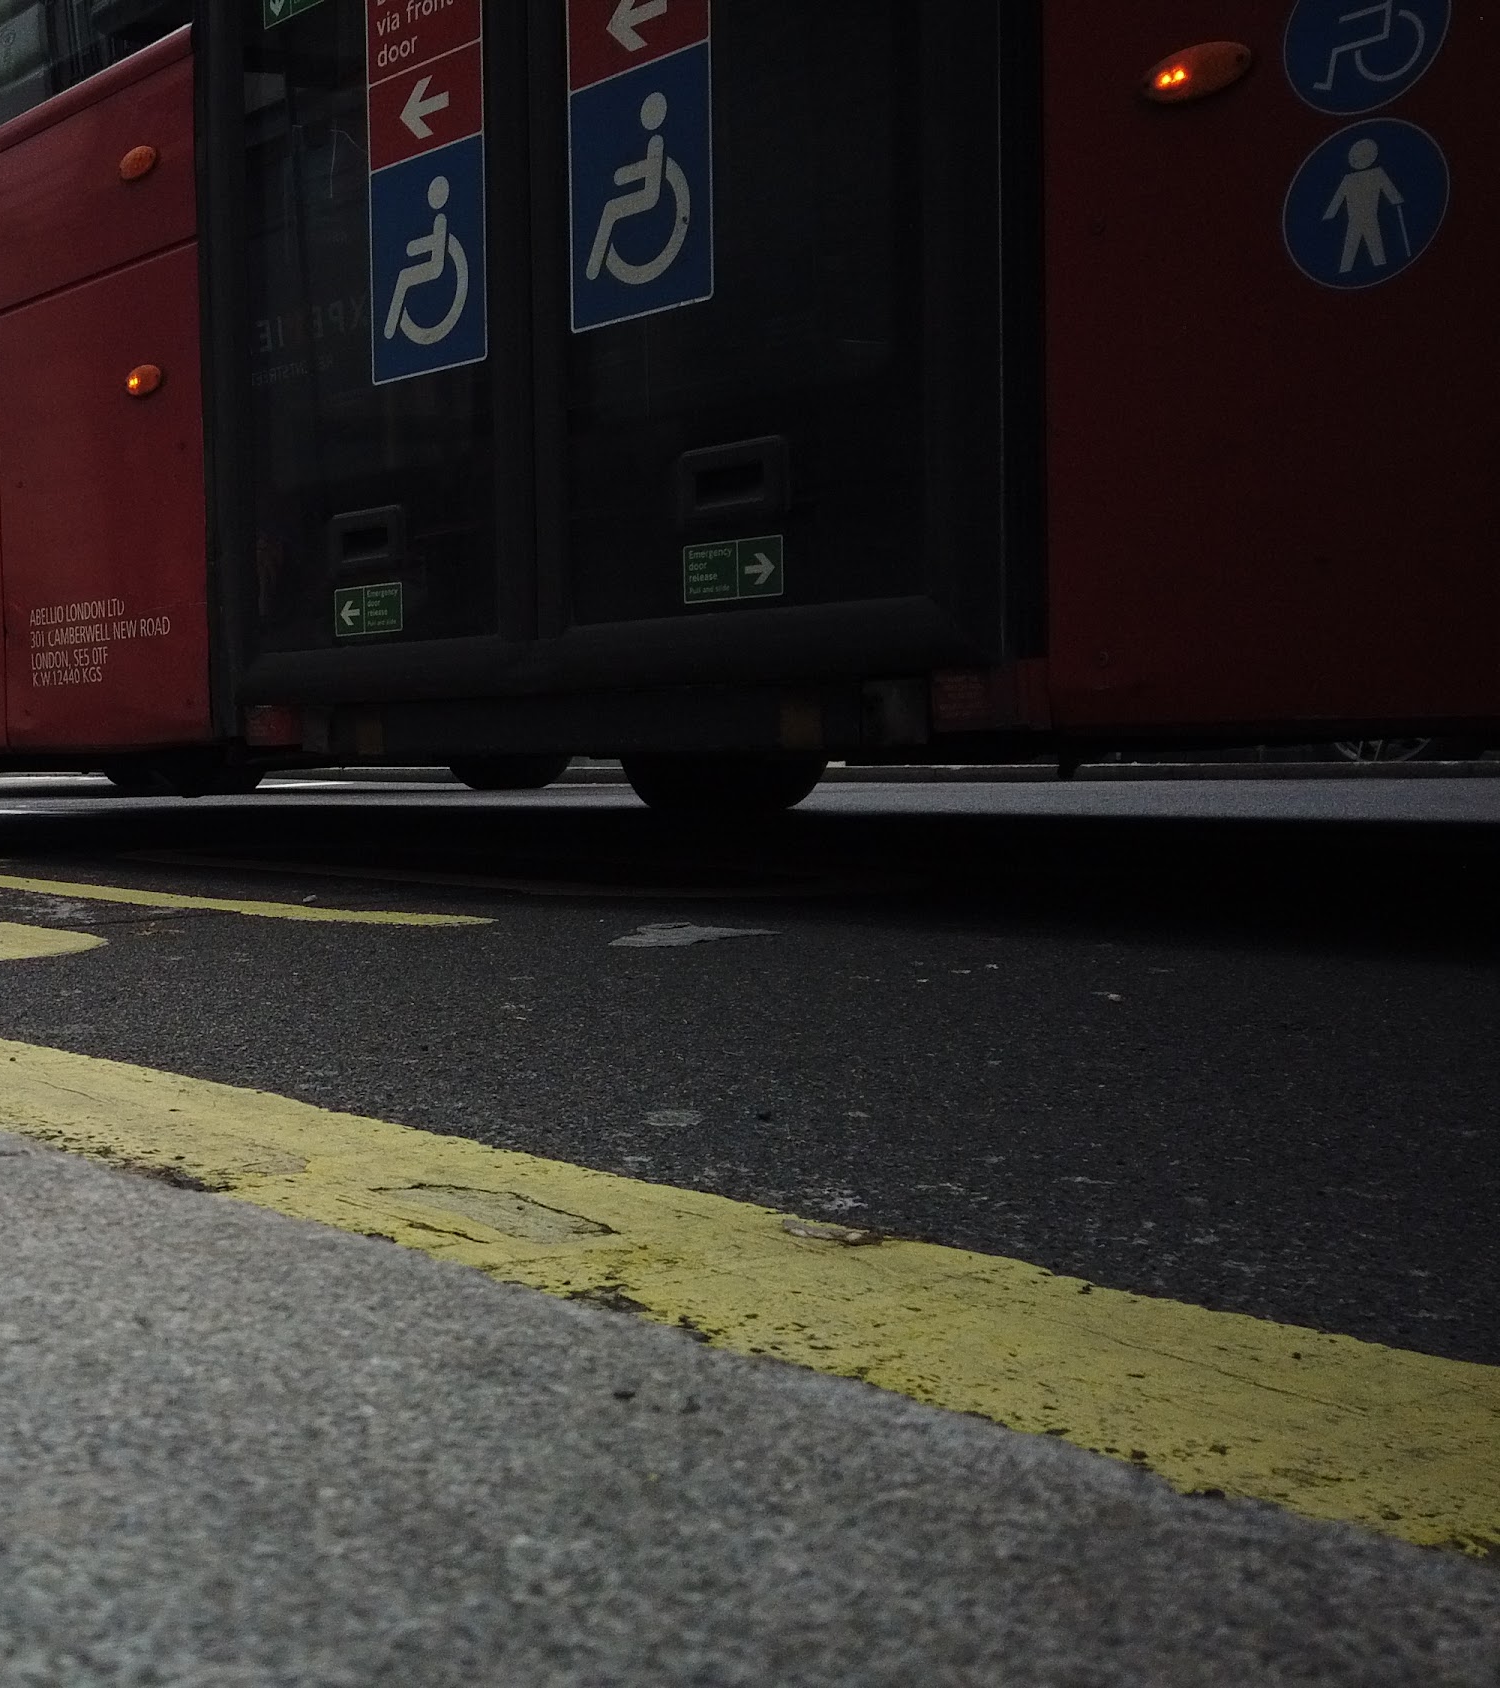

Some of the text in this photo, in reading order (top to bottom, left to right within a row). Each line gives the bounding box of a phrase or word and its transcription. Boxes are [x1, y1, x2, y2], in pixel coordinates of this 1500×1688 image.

[376, 0, 454, 37] via fron
[376, 34, 418, 68] door
[688, 547, 732, 560] Emergency
[688, 561, 708, 572] door
[688, 573, 718, 583] release
[366, 588, 398, 598] Emergency
[29, 597, 125, 627] ABELLIO LONDON LTD
[367, 608, 388, 617] release
[30, 616, 172, 649] 301 CAMBERWELL NEW ROAD
[30, 650, 72, 671] LONDON,
[73, 648, 90, 667] SE5
[82, 666, 103, 684] KGS
